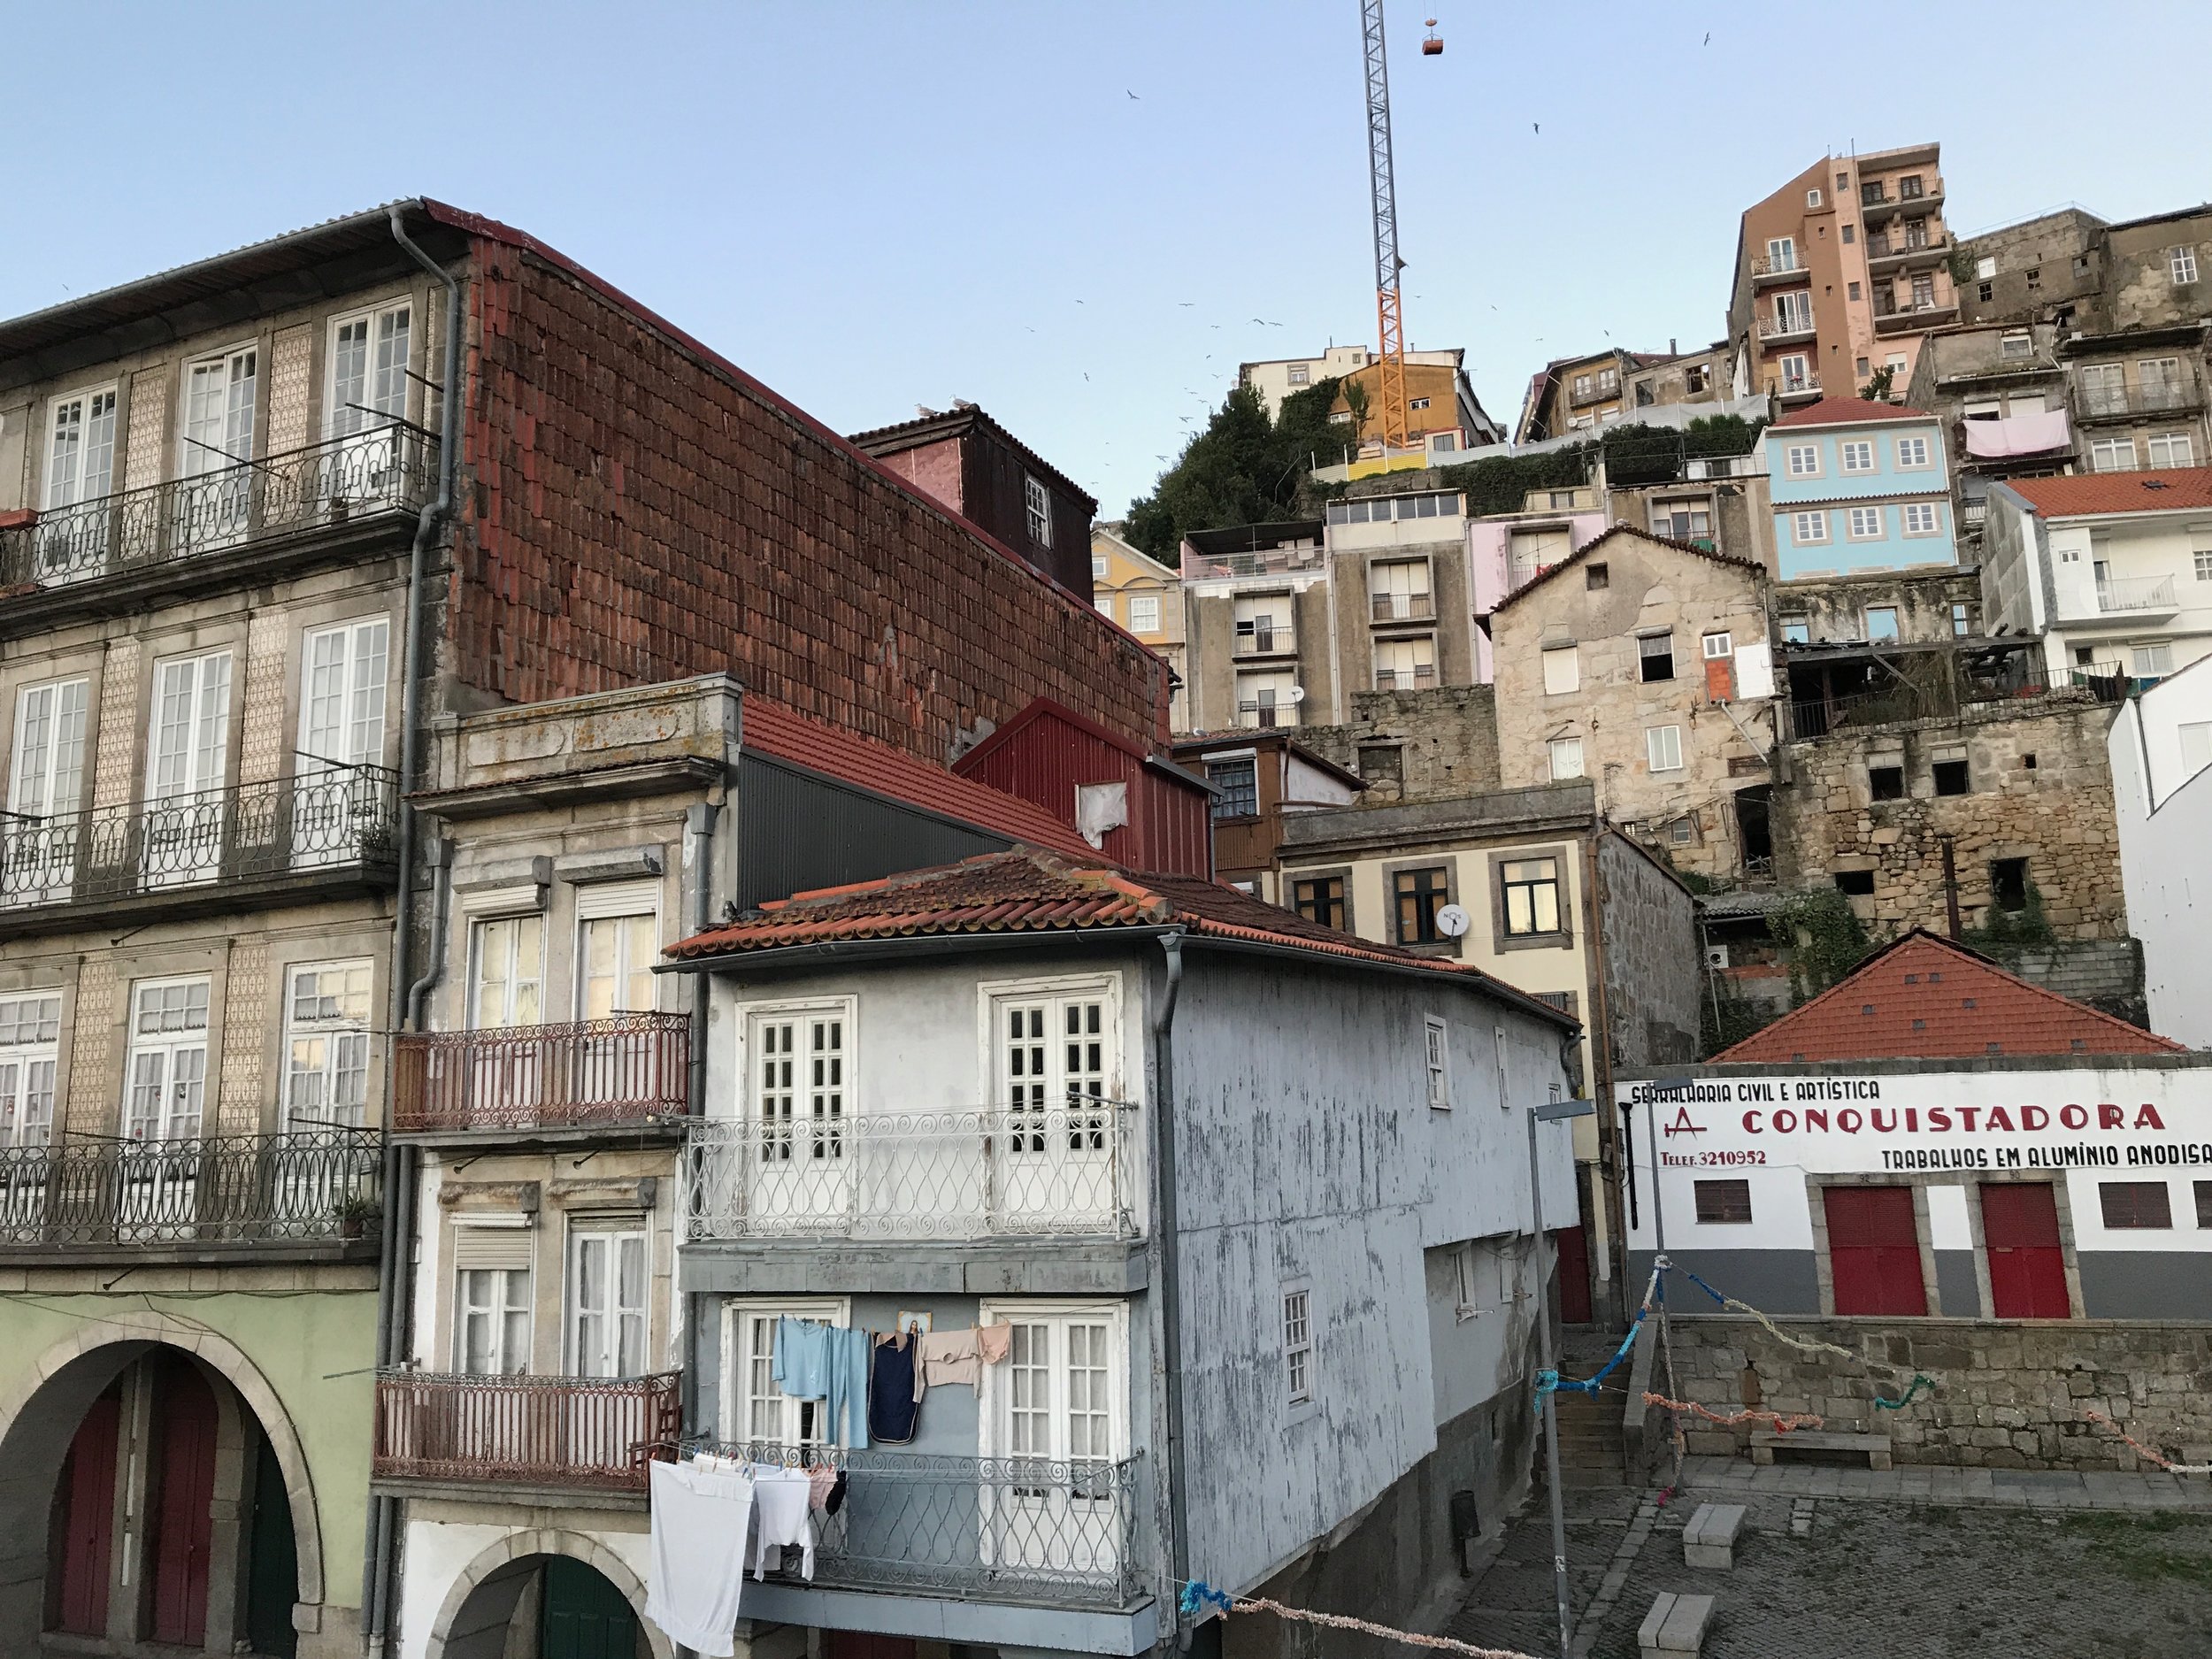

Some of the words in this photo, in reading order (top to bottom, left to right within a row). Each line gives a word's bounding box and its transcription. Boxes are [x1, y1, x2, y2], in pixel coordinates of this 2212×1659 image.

[1738, 1083, 1775, 1102] CIVIL
[1780, 1082, 1789, 1101] E
[1795, 1077, 1880, 1101] ARTÍSTICA
[1742, 1103, 2165, 1134] CONQUISTADORA
[1698, 1150, 1766, 1166] 3210952
[1882, 1147, 1988, 1170] TRABALHOS
[1996, 1147, 2021, 1168] EM
[2028, 1141, 2119, 1167] ALUMÍNIO
[2126, 1144, 2212, 1166] ANODISA
